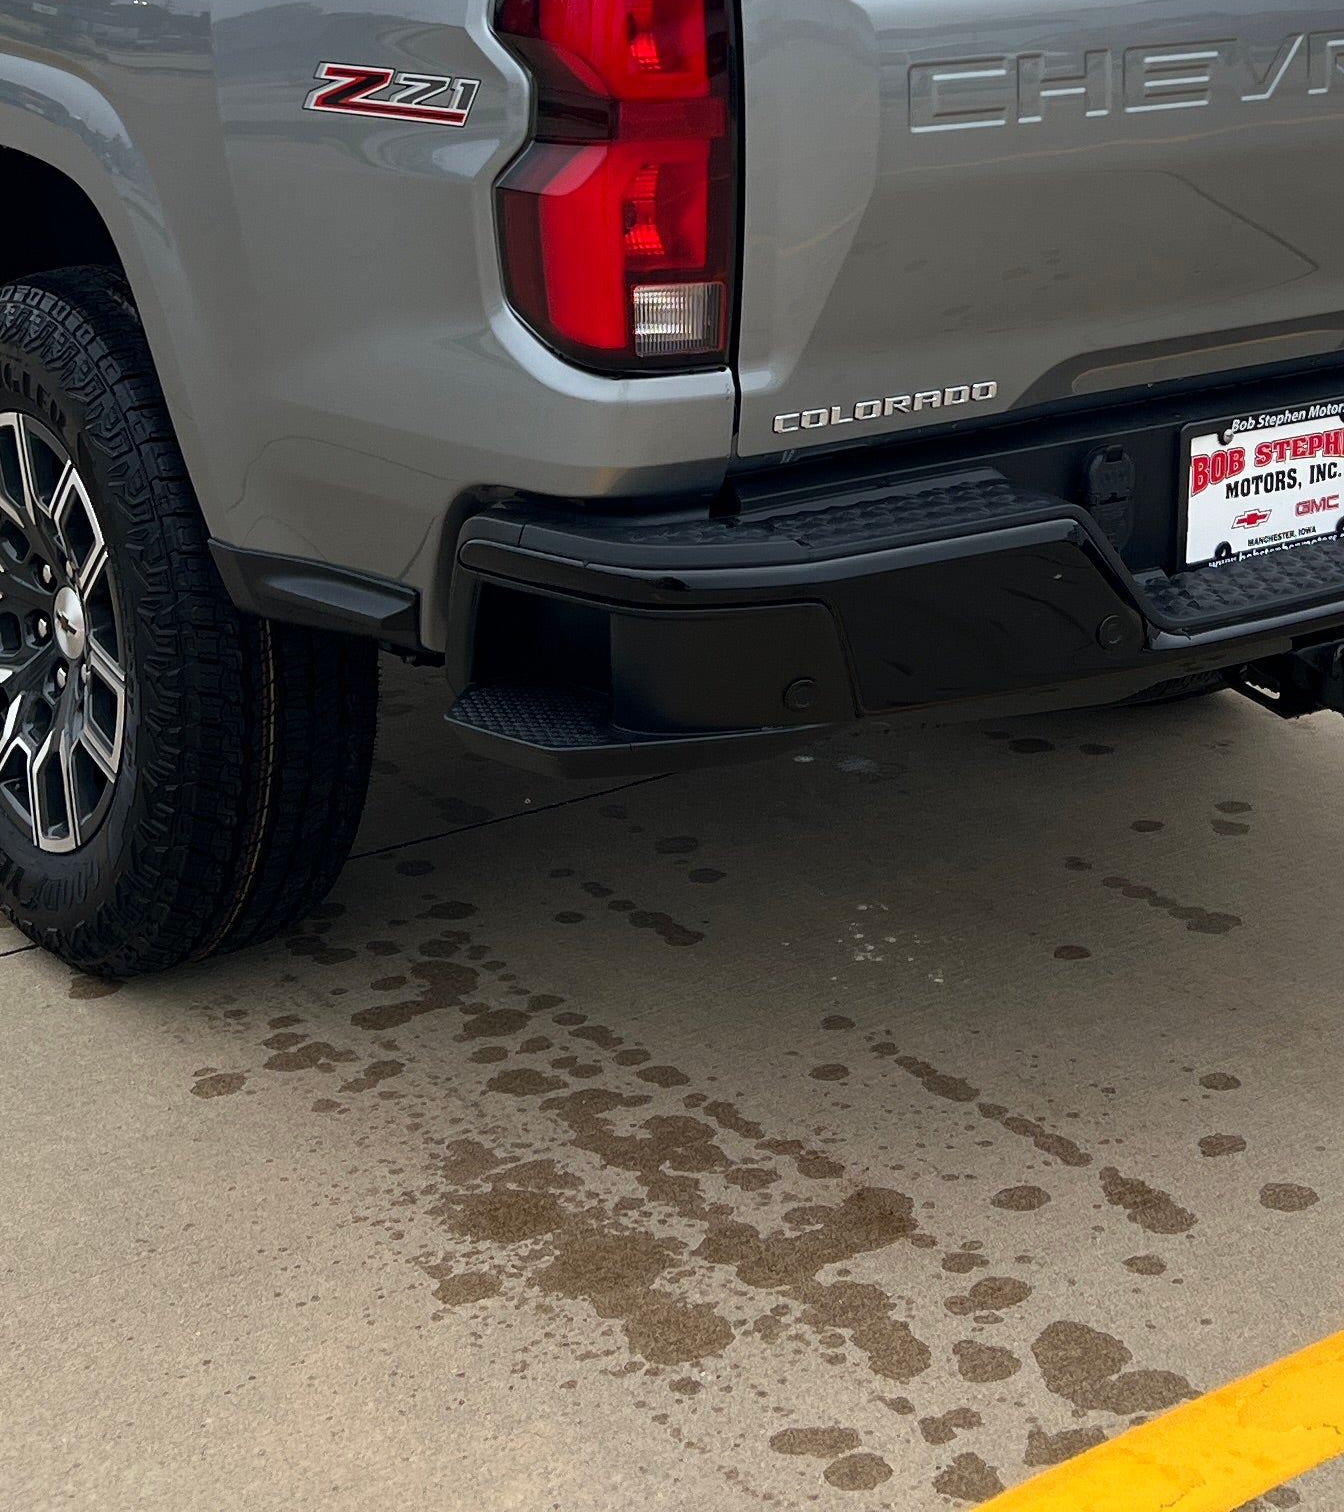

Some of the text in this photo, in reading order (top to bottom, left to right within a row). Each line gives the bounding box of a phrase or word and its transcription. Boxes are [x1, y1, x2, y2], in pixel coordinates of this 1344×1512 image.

[302, 61, 481, 128] Z71
[773, 381, 998, 434] COLORADO
[1231, 416, 1256, 432] Bob
[1256, 409, 1306, 428] Stephen
[1190, 447, 1246, 496] BOB
[1225, 461, 1343, 499] MOTORS, INC.
[1295, 494, 1339, 517] GMC
[1298, 525, 1317, 536] IOWA
